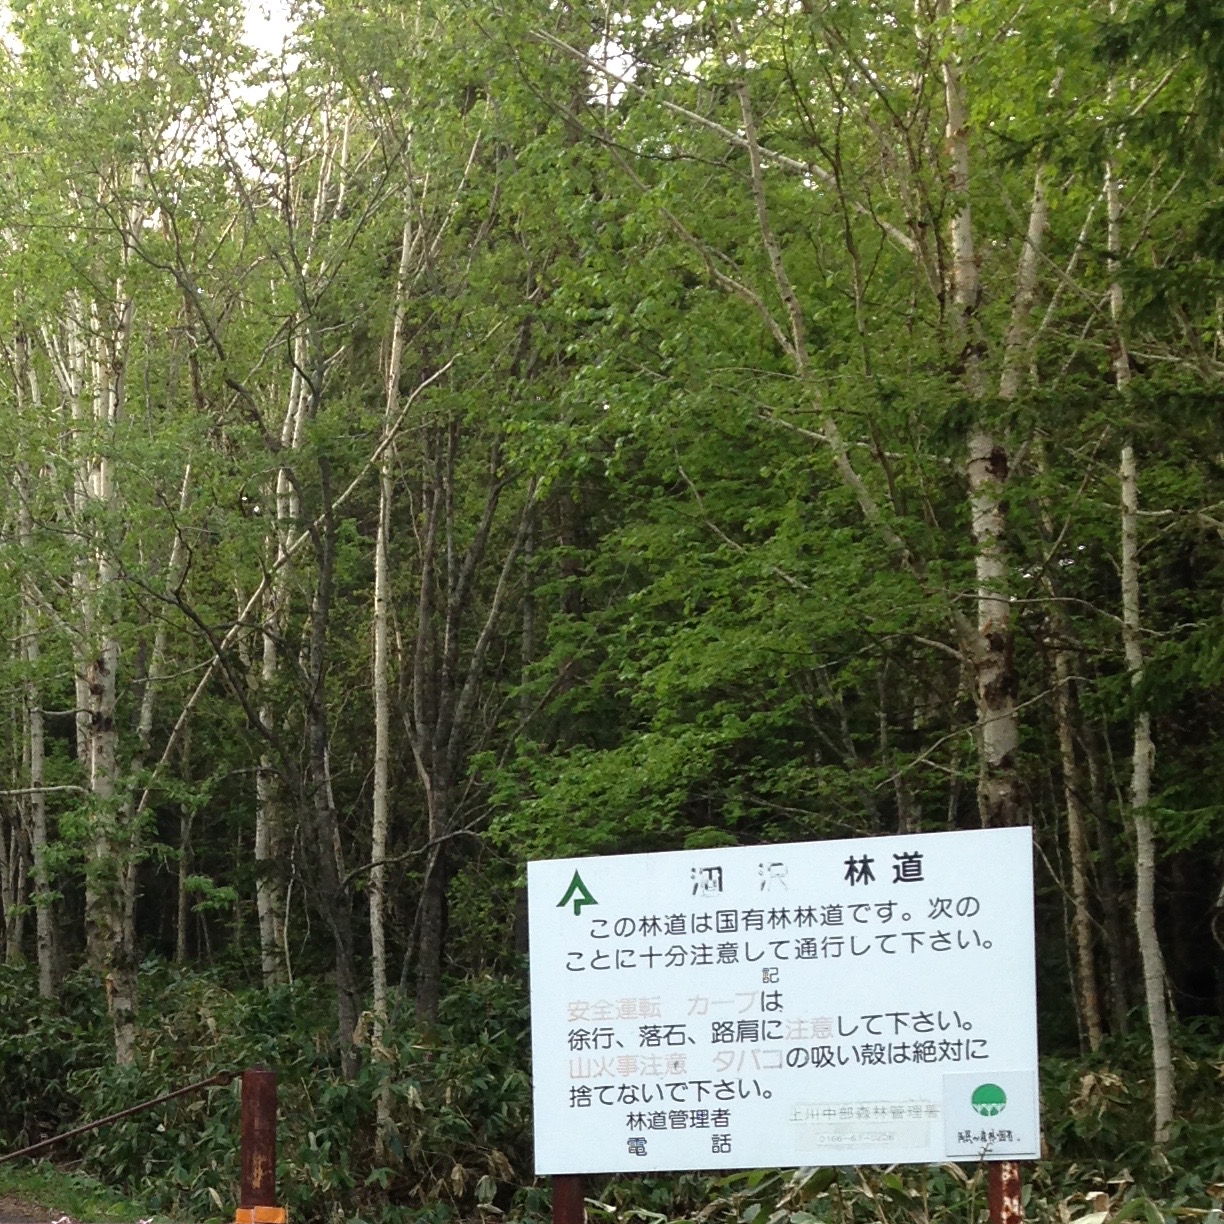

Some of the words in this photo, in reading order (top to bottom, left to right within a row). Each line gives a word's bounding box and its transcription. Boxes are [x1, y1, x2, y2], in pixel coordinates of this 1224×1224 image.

[844, 851, 924, 887] 林道
[590, 896, 980, 940] この林道は国有林林道です。次の
[565, 929, 993, 972] ことに十分注意して通行して下さい。
[761, 967, 779, 984] 記
[568, 997, 663, 1023] 安全運転
[687, 990, 784, 1017] カーブは
[567, 1010, 974, 1052] 徐行、落石、路肩に注意して下さい。
[568, 1050, 688, 1080] 山火事注意
[713, 1038, 989, 1074] タバコの吸い殻は絶対に
[569, 1078, 773, 1109] 捨てないで下さい。
[626, 1108, 732, 1132] 林道管理者
